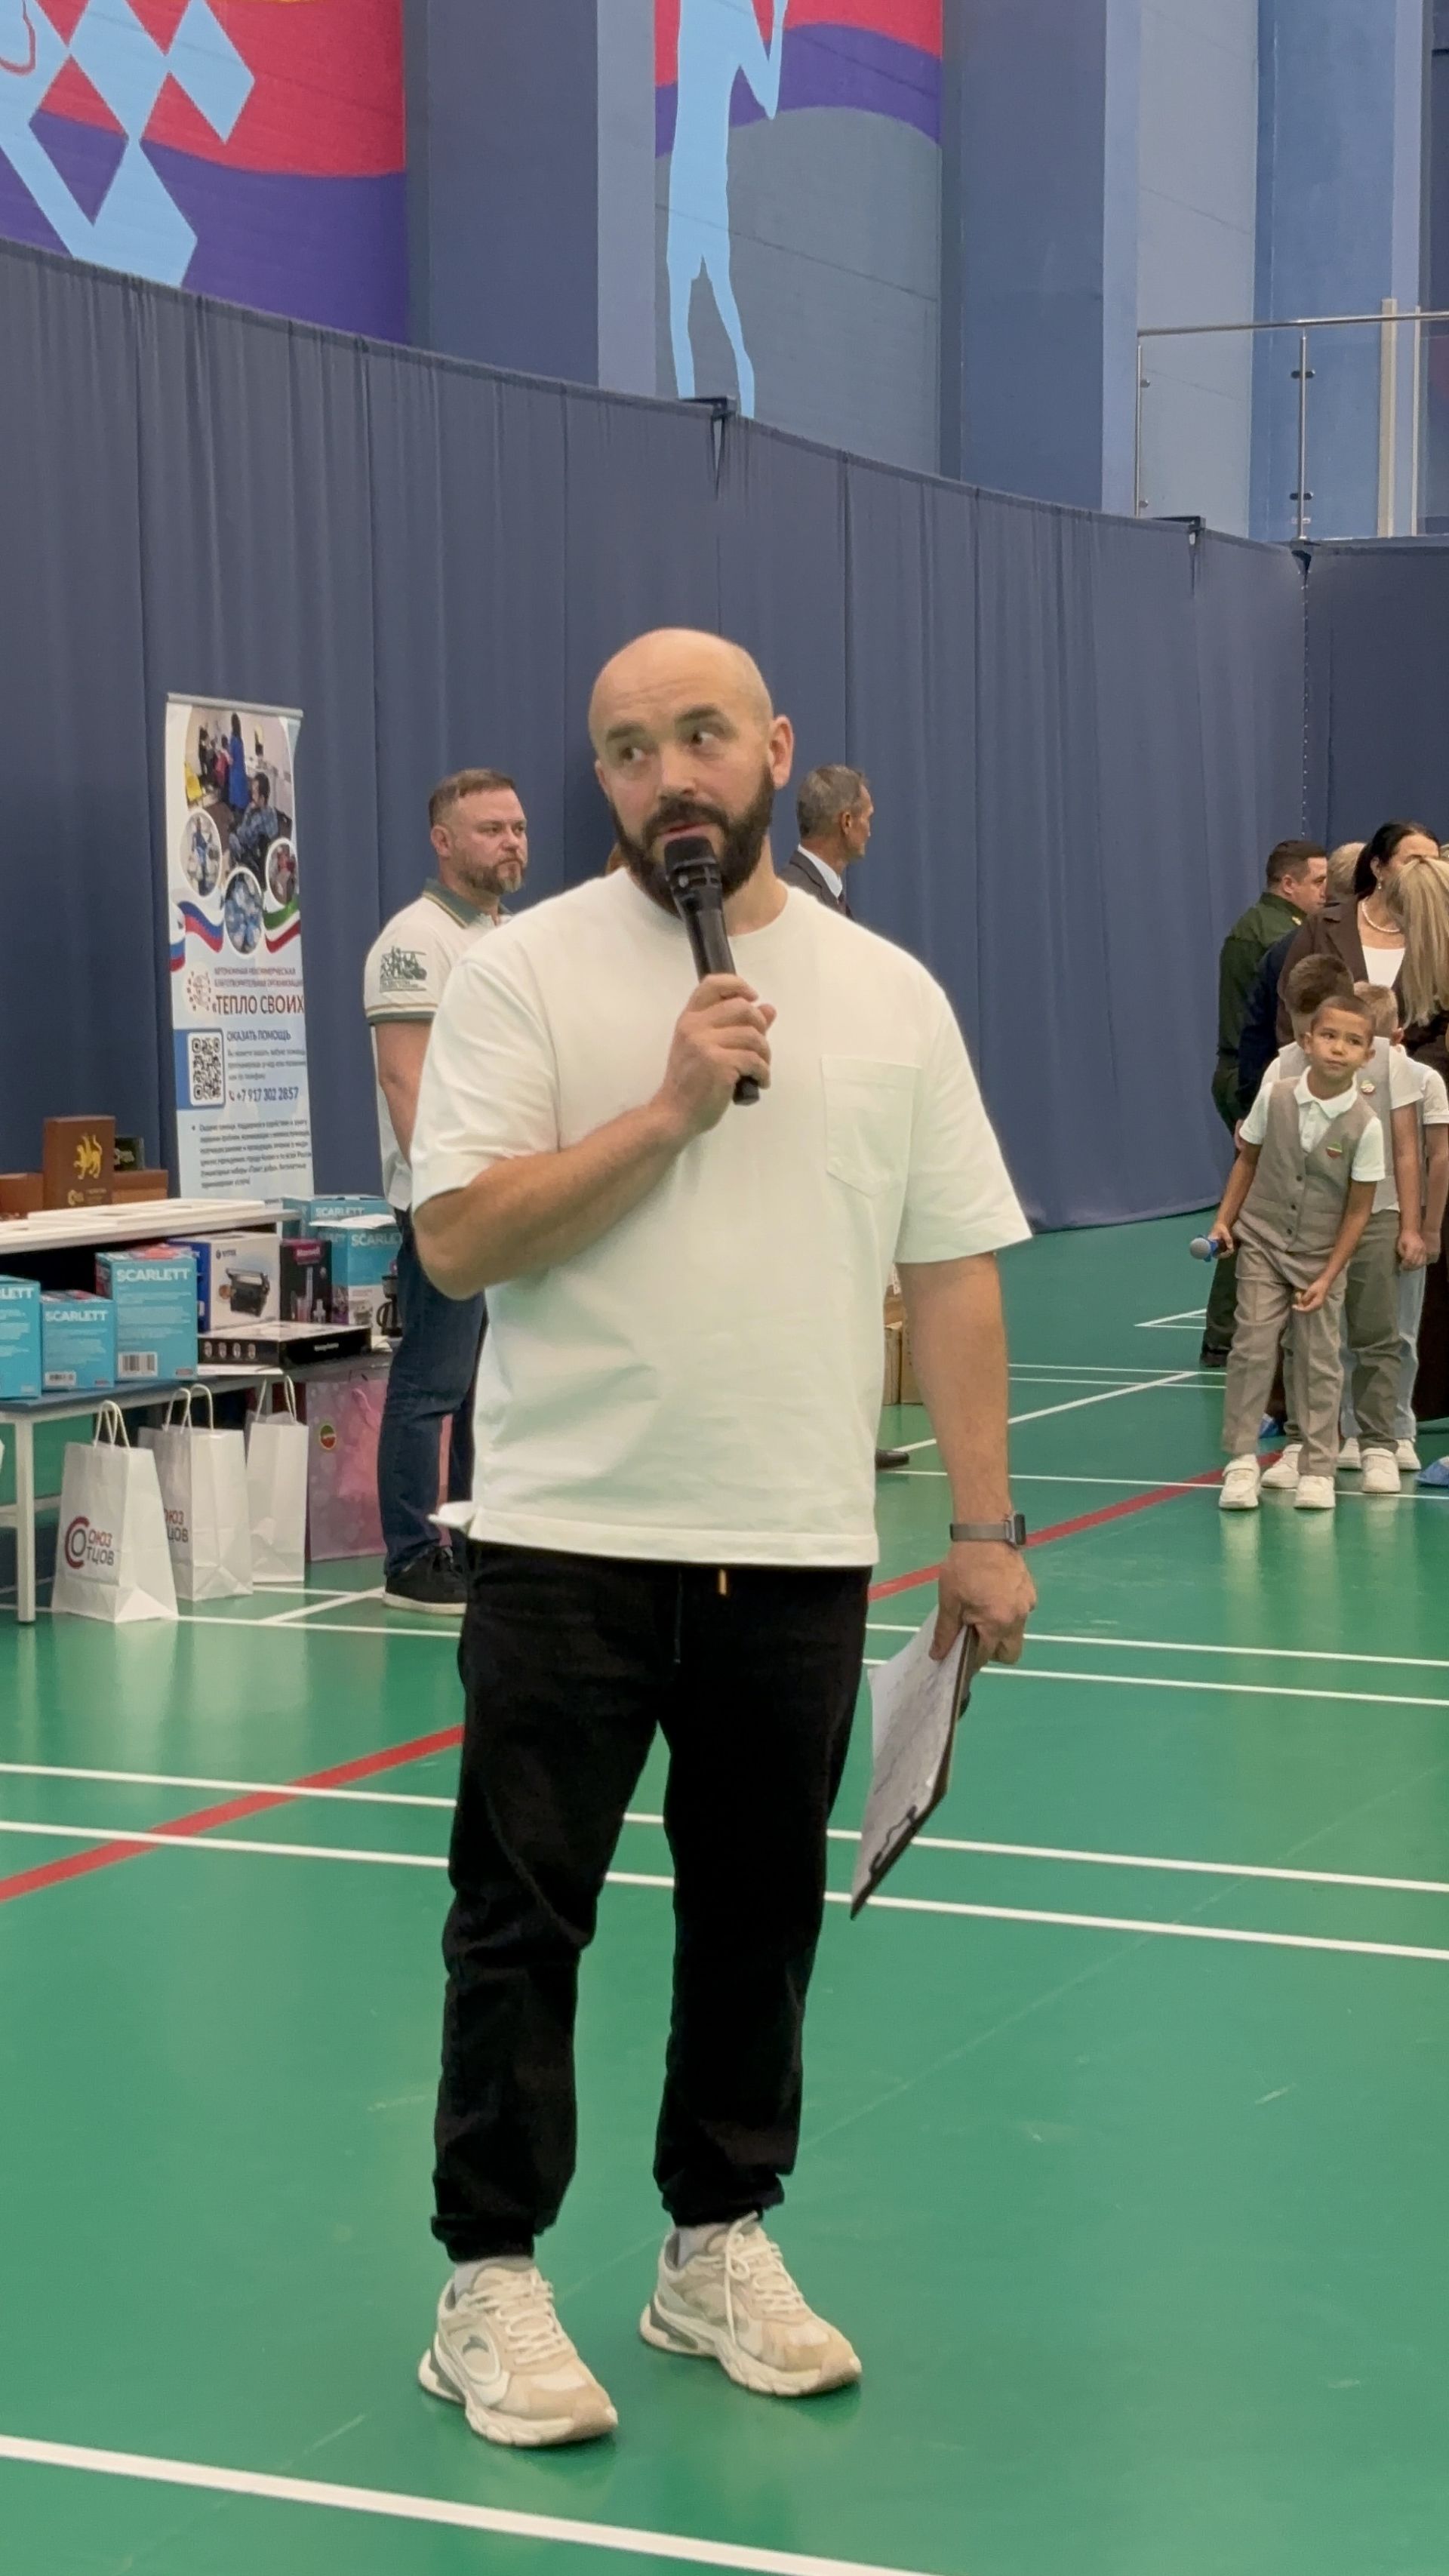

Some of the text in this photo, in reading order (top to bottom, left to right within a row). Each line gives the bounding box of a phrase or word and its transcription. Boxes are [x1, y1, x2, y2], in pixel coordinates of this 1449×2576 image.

[116, 1268, 189, 1282] SCARLETT
[0, 1287, 34, 1300] LETT
[45, 1310, 108, 1322] SCARLETT
[163, 1508, 184, 1525] ОЮЗ
[167, 1526, 189, 1543] ЦОВ
